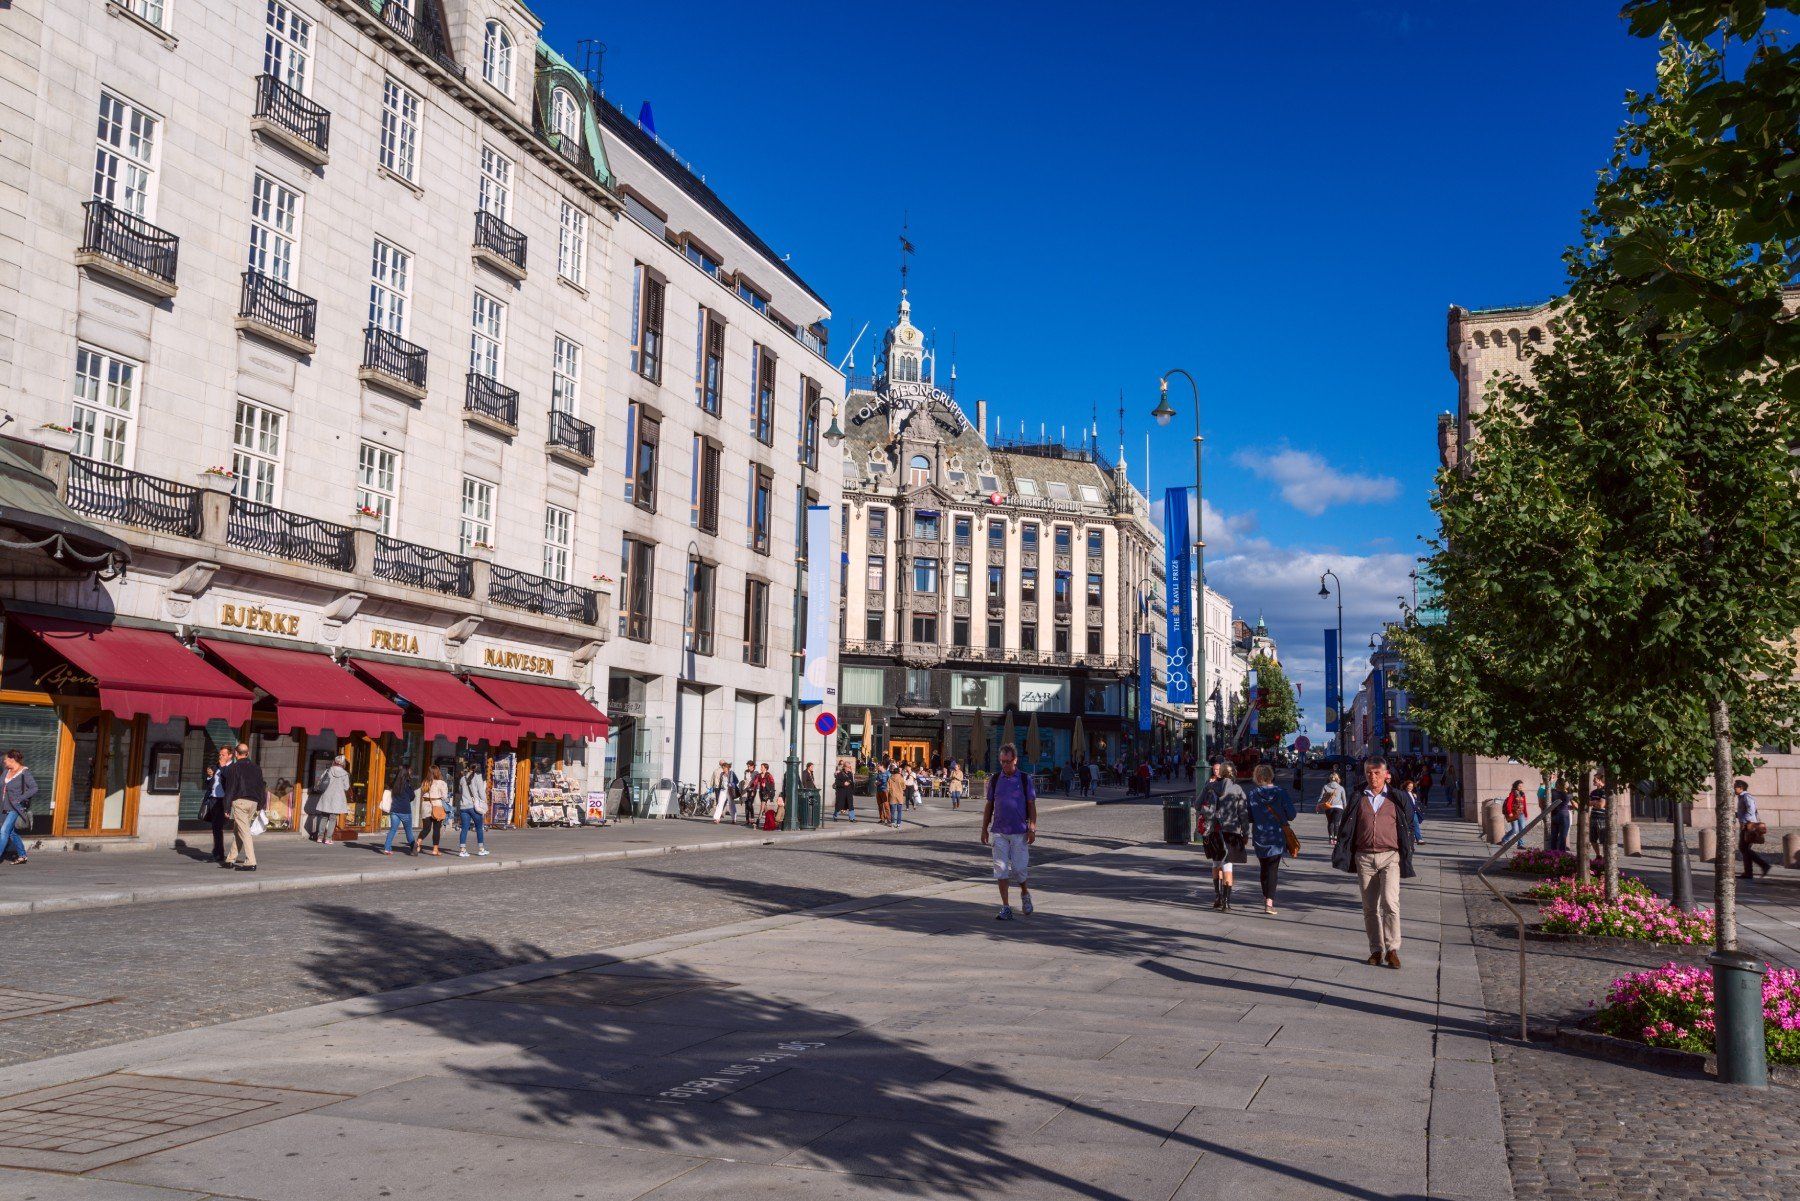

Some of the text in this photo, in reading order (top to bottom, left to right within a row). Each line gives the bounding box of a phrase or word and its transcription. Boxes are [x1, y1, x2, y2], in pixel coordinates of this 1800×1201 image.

[859, 383, 970, 432] OLAV THON GRUPPEN
[1171, 559, 1179, 581] PRIZE
[1172, 583, 1180, 603] KAVLI
[221, 603, 300, 637] BJERKE
[371, 629, 419, 654] FREIA
[484, 648, 554, 676] NARVESEN
[34, 663, 99, 691] Bjerk
[1021, 691, 1061, 703] ZARA
[589, 800, 602, 808] 20
